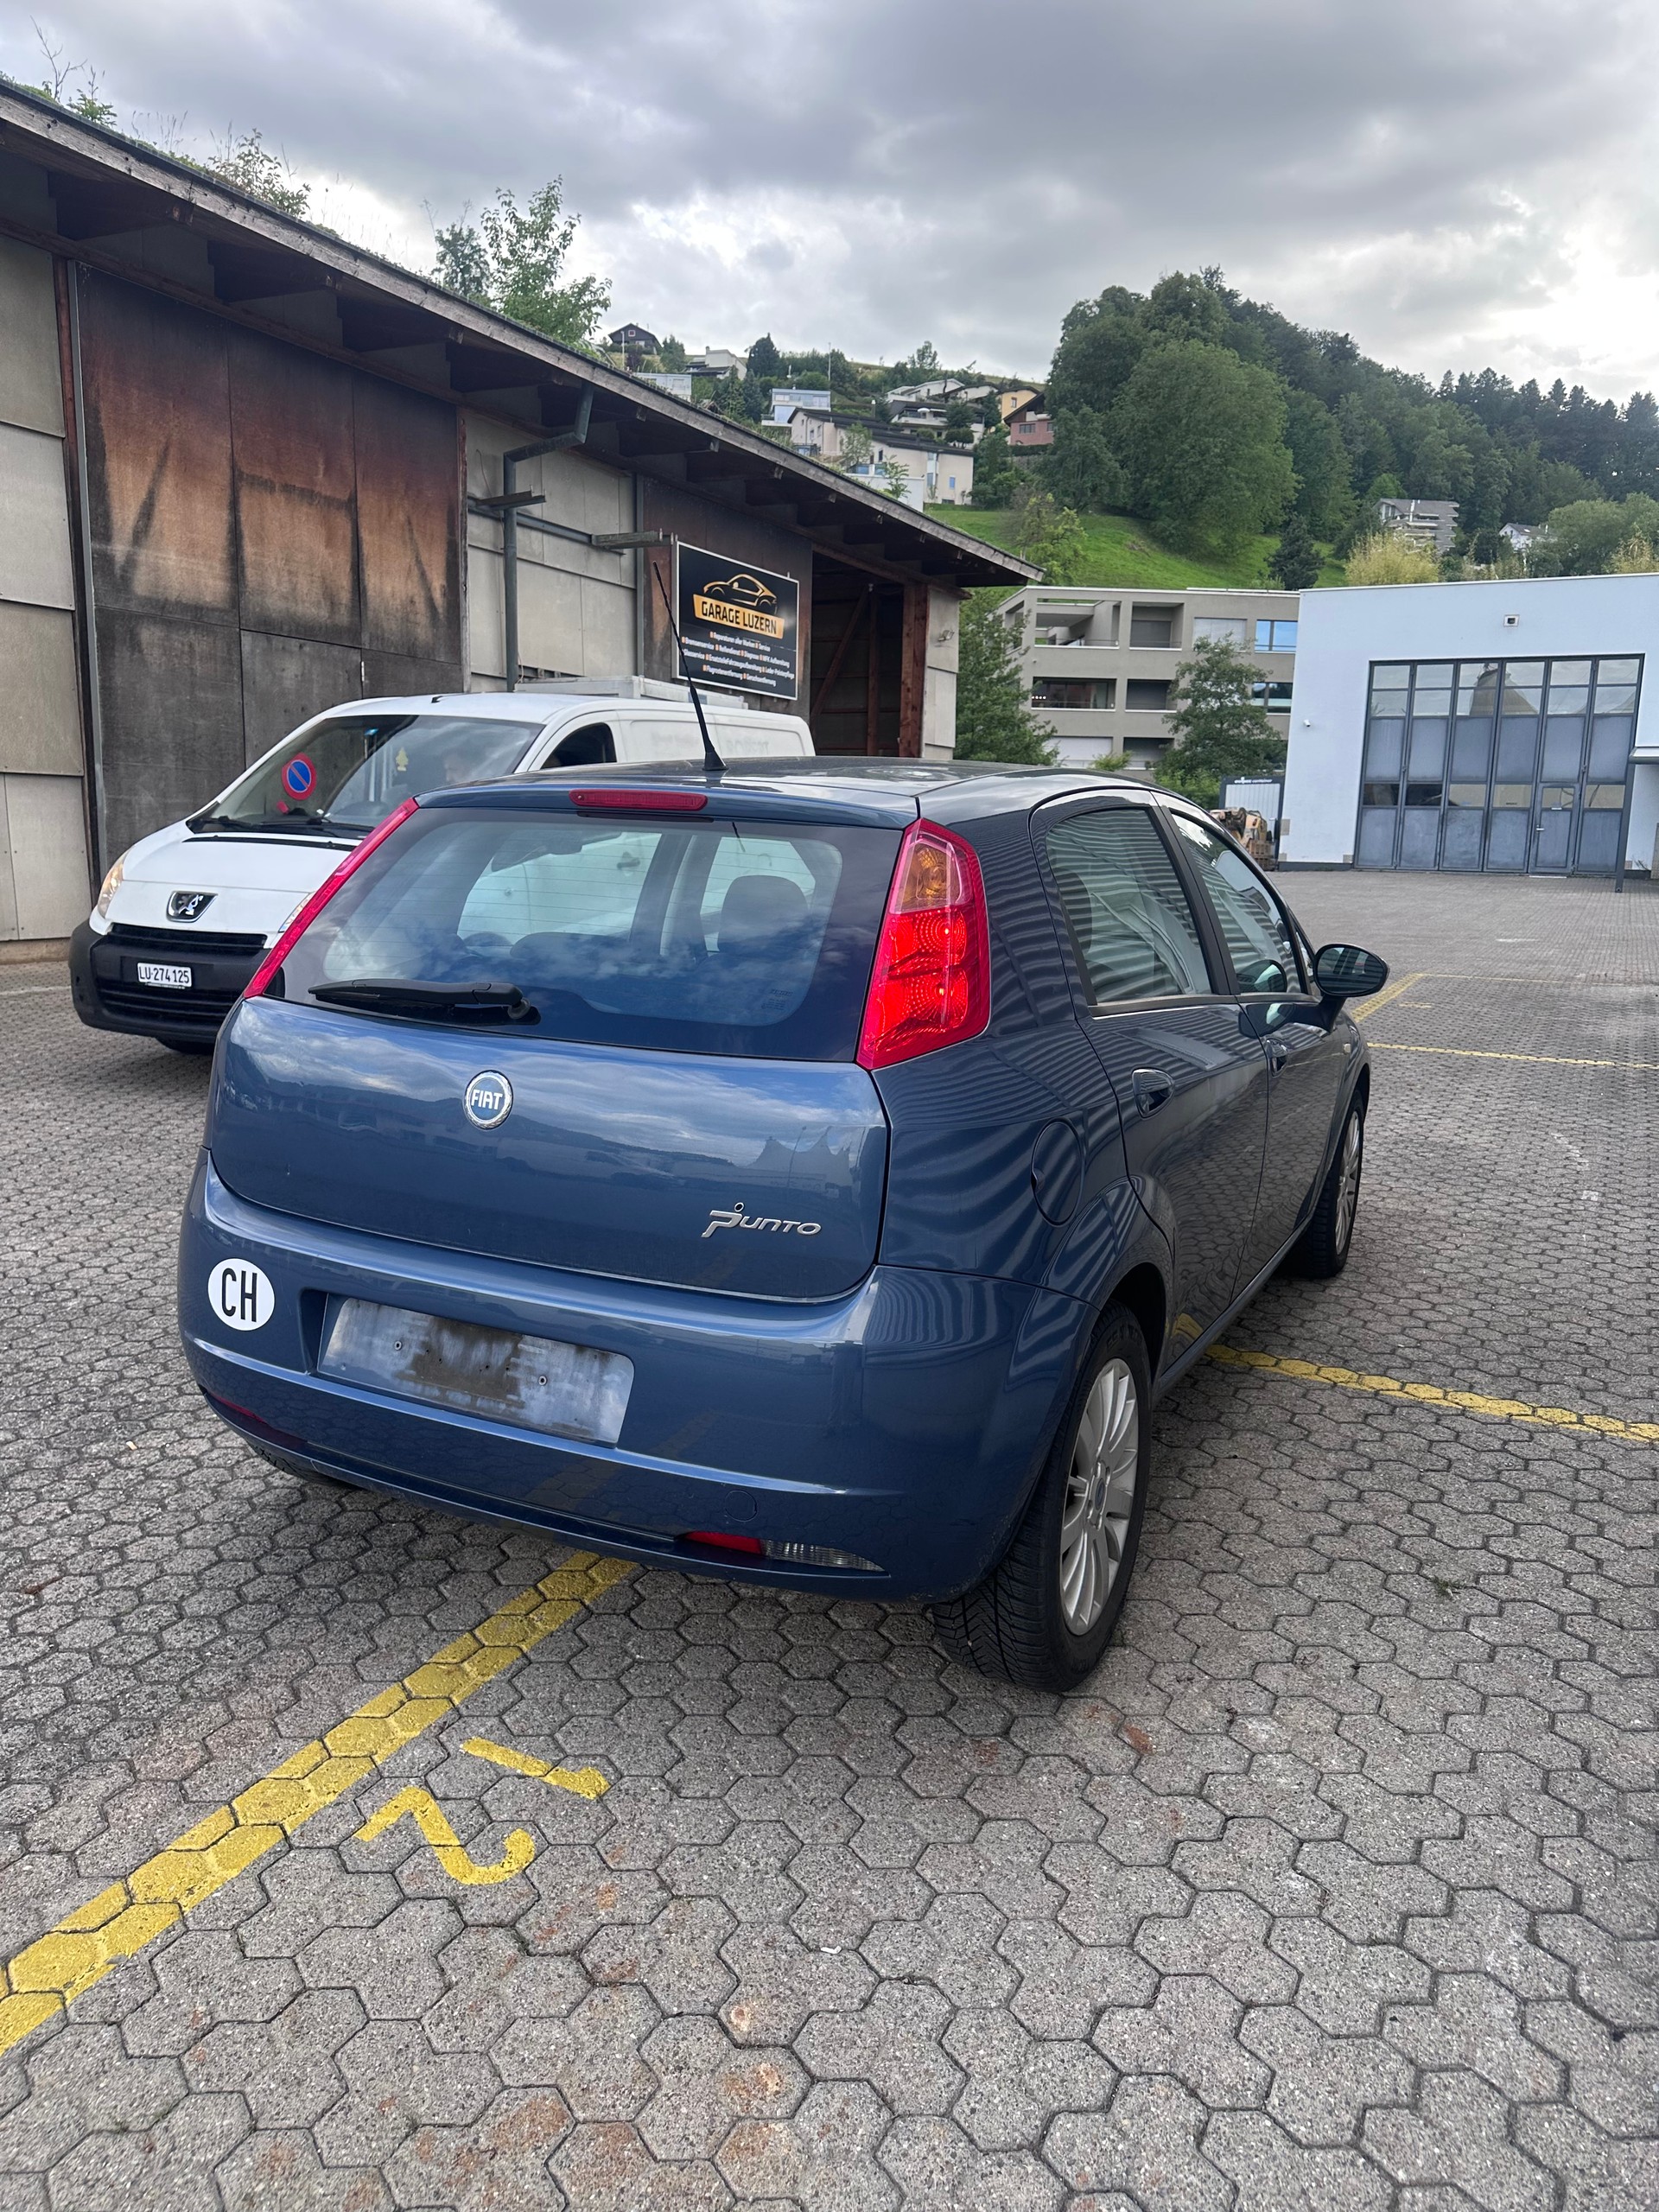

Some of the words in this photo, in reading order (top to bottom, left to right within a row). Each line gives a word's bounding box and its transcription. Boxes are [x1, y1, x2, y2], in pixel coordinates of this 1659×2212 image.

[702, 601, 741, 625] GARAGE
[743, 612, 777, 634] LUZERN
[471, 1089, 504, 1110] FIAT
[221, 1267, 258, 1323] CH
